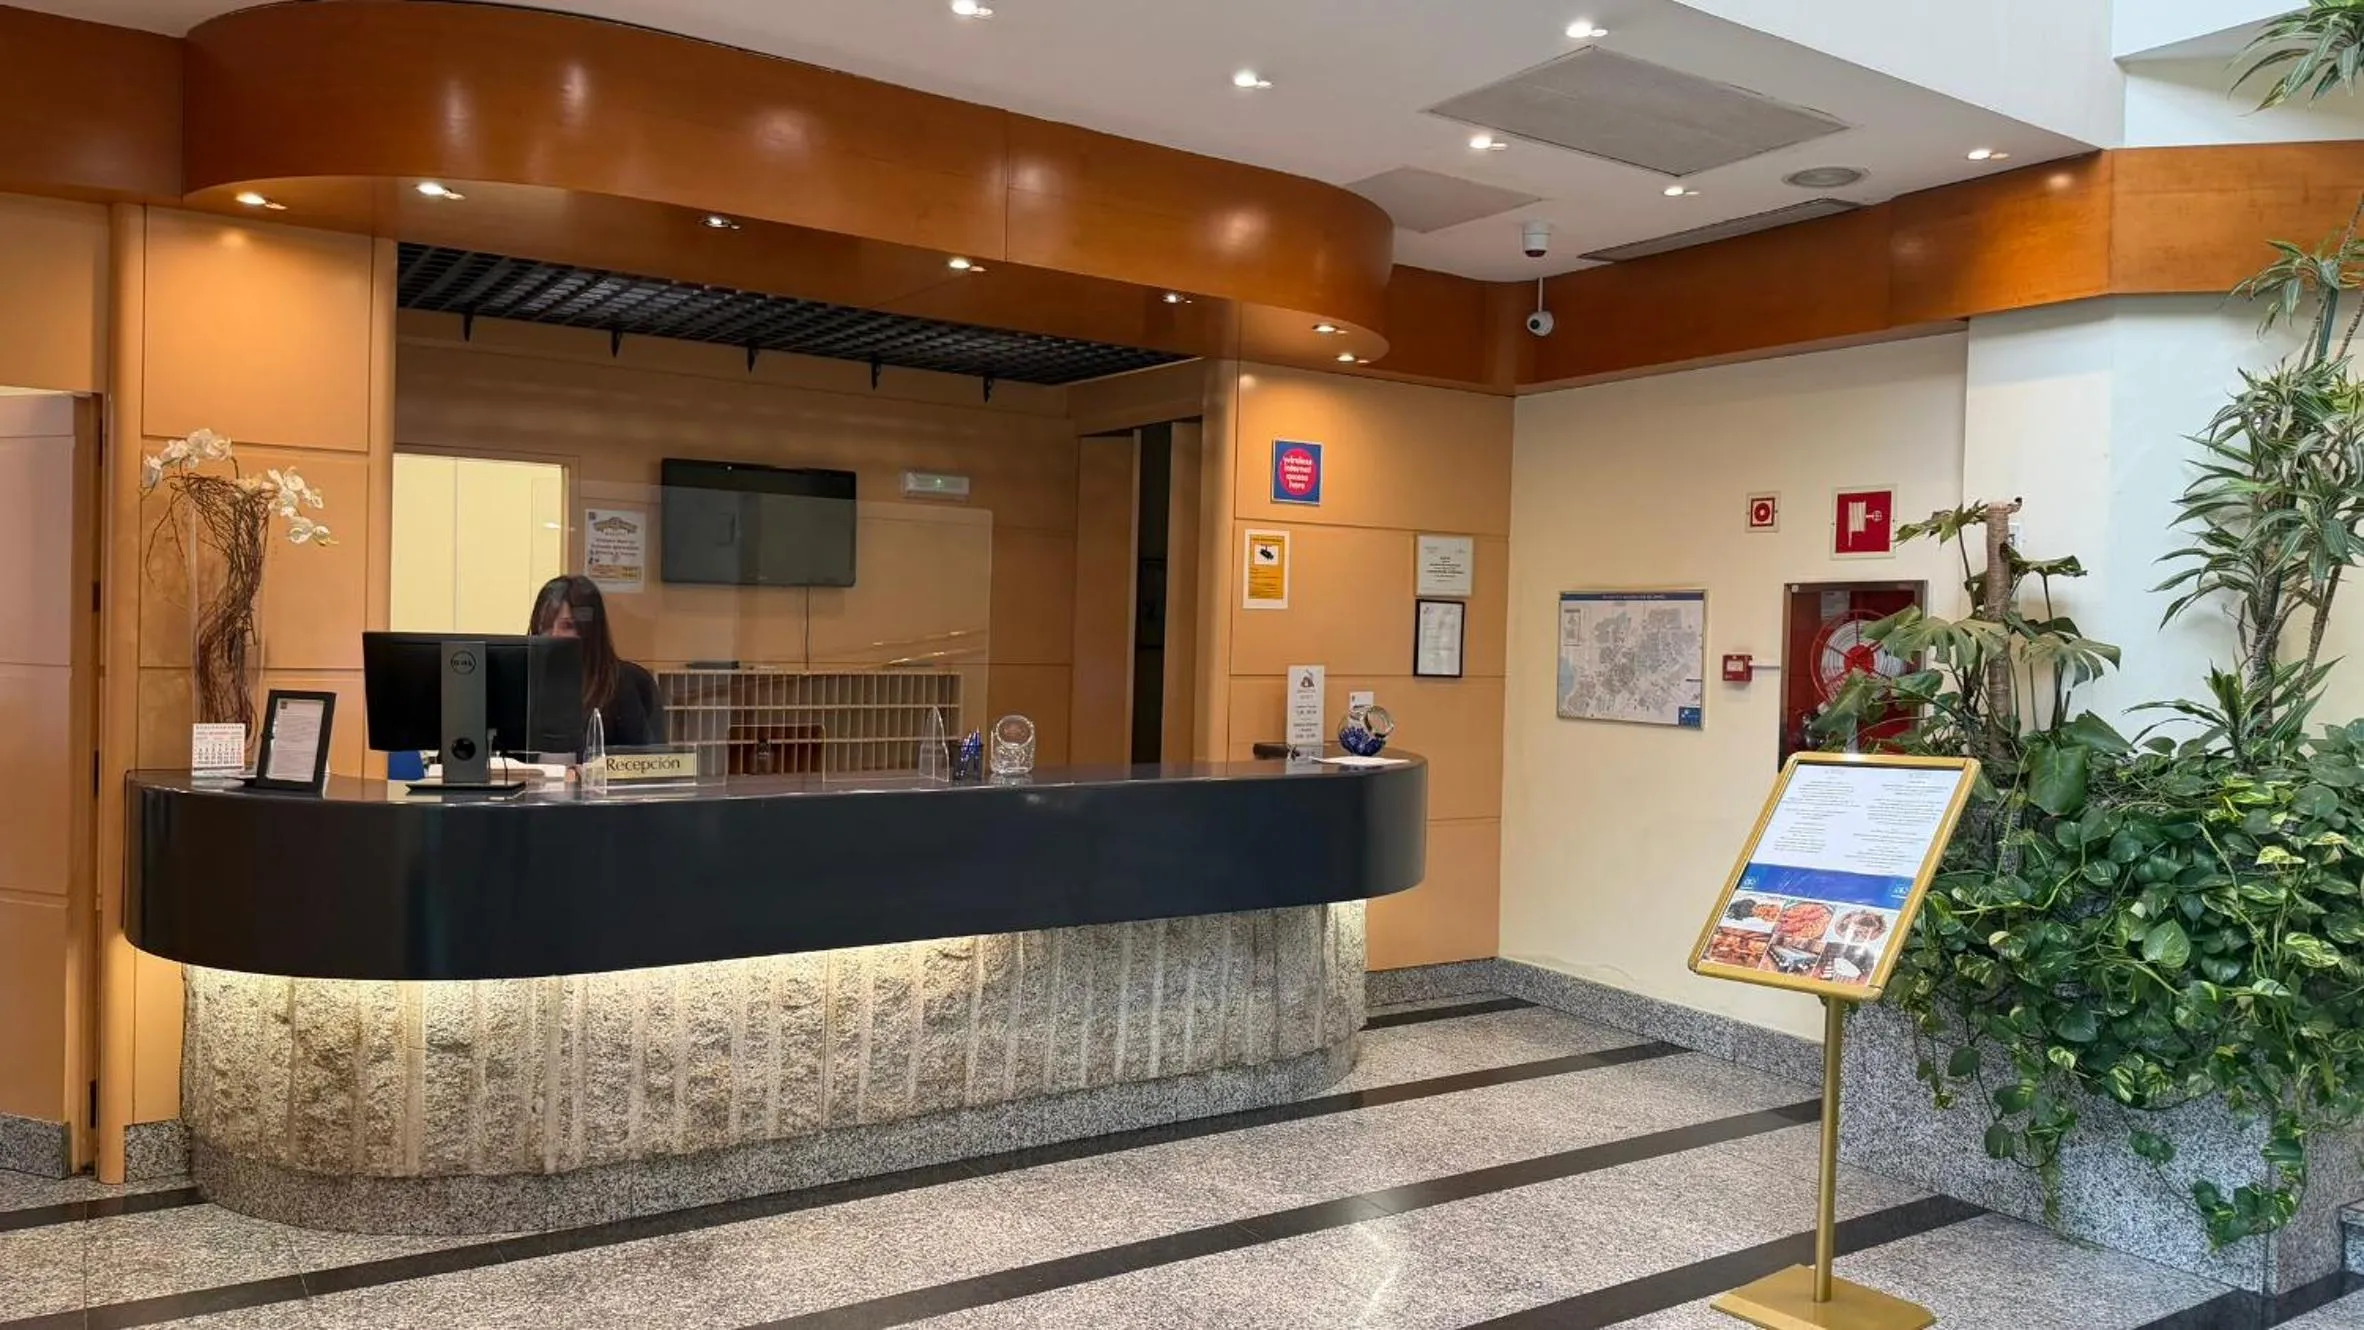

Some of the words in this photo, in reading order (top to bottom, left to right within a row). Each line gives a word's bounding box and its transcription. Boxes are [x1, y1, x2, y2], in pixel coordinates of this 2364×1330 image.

[1282, 455, 1312, 465] wireless
[1284, 465, 1312, 473] internet
[1289, 480, 1305, 490] here
[606, 757, 680, 773] Recepción
